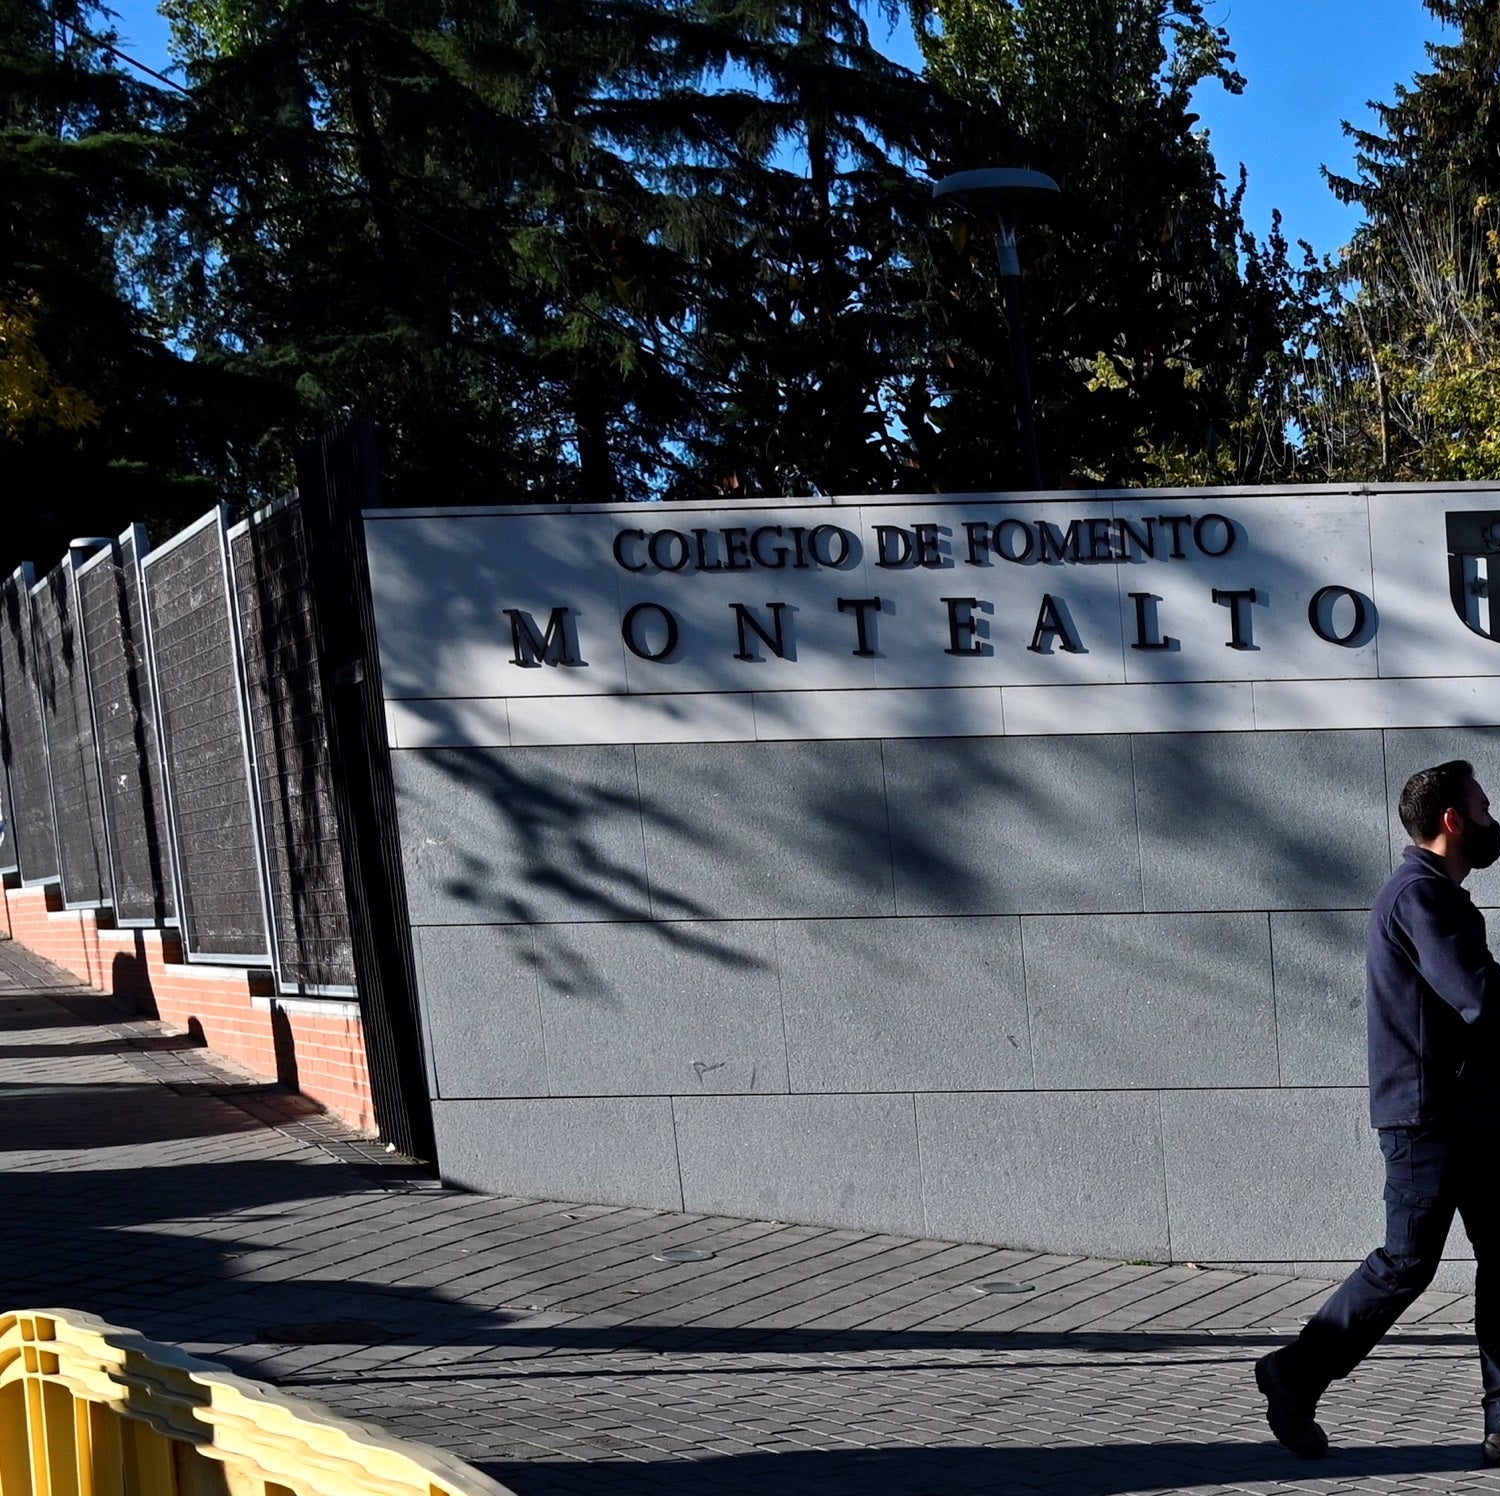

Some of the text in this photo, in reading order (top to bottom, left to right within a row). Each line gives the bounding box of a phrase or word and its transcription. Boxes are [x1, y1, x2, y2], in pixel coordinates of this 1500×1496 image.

[613, 513, 1236, 571] COLEGIO DE FOMENTO
[502, 584, 1366, 666] MONTEALTO
